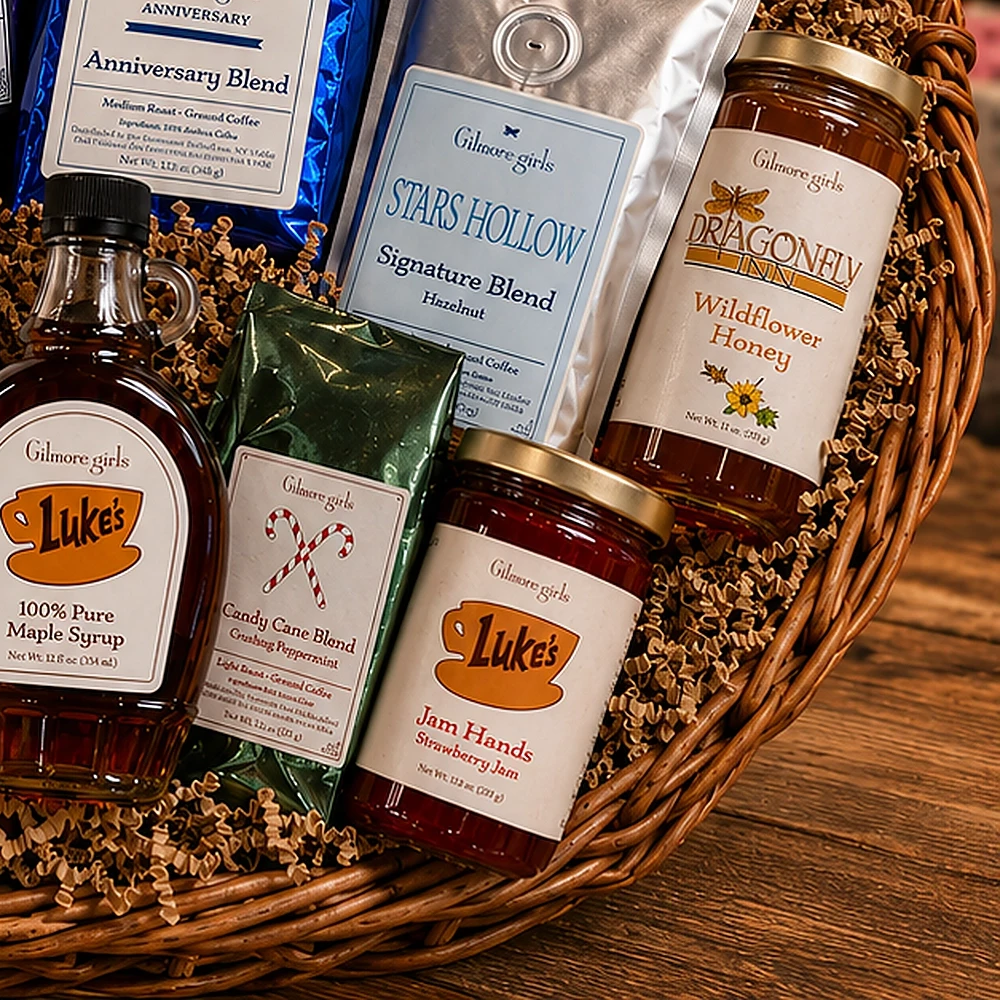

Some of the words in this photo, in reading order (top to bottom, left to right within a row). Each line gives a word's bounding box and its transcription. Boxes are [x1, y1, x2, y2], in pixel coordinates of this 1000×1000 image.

[142, 2, 251, 27] ANNIVERSARY
[83, 49, 222, 91] Anniversary
[226, 68, 290, 95] Blend
[226, 114, 260, 127] Coffee
[454, 125, 515, 161] Gilmore
[516, 148, 555, 176] girls
[752, 147, 809, 184] Gilmore
[810, 169, 845, 194] girls
[385, 178, 464, 231] STARS
[462, 198, 587, 265] HOLLOW
[686, 213, 864, 289] DRAGONFLY
[735, 254, 797, 290] INN
[376, 244, 482, 292] Signature
[486, 274, 556, 312] Blend
[422, 291, 486, 321] Hazelnut
[694, 292, 823, 349] Wildflower
[709, 323, 792, 374] Honey
[25, 438, 89, 466] Gilmore
[89, 446, 130, 475] girls
[489, 558, 539, 591] Gilmore
[539, 582, 570, 603] girls
[6, 621, 64, 644] Maple
[68, 626, 125, 650] Syrup
[18, 601, 67, 619] 100%
[71, 604, 115, 623] Pure
[222, 603, 269, 632] Candy
[272, 617, 310, 640] Cane
[312, 627, 357, 654] Blend
[415, 705, 458, 736] Jam
[462, 720, 534, 763] Hands
[415, 731, 490, 773] Strawberry
[491, 760, 519, 780] Jam
